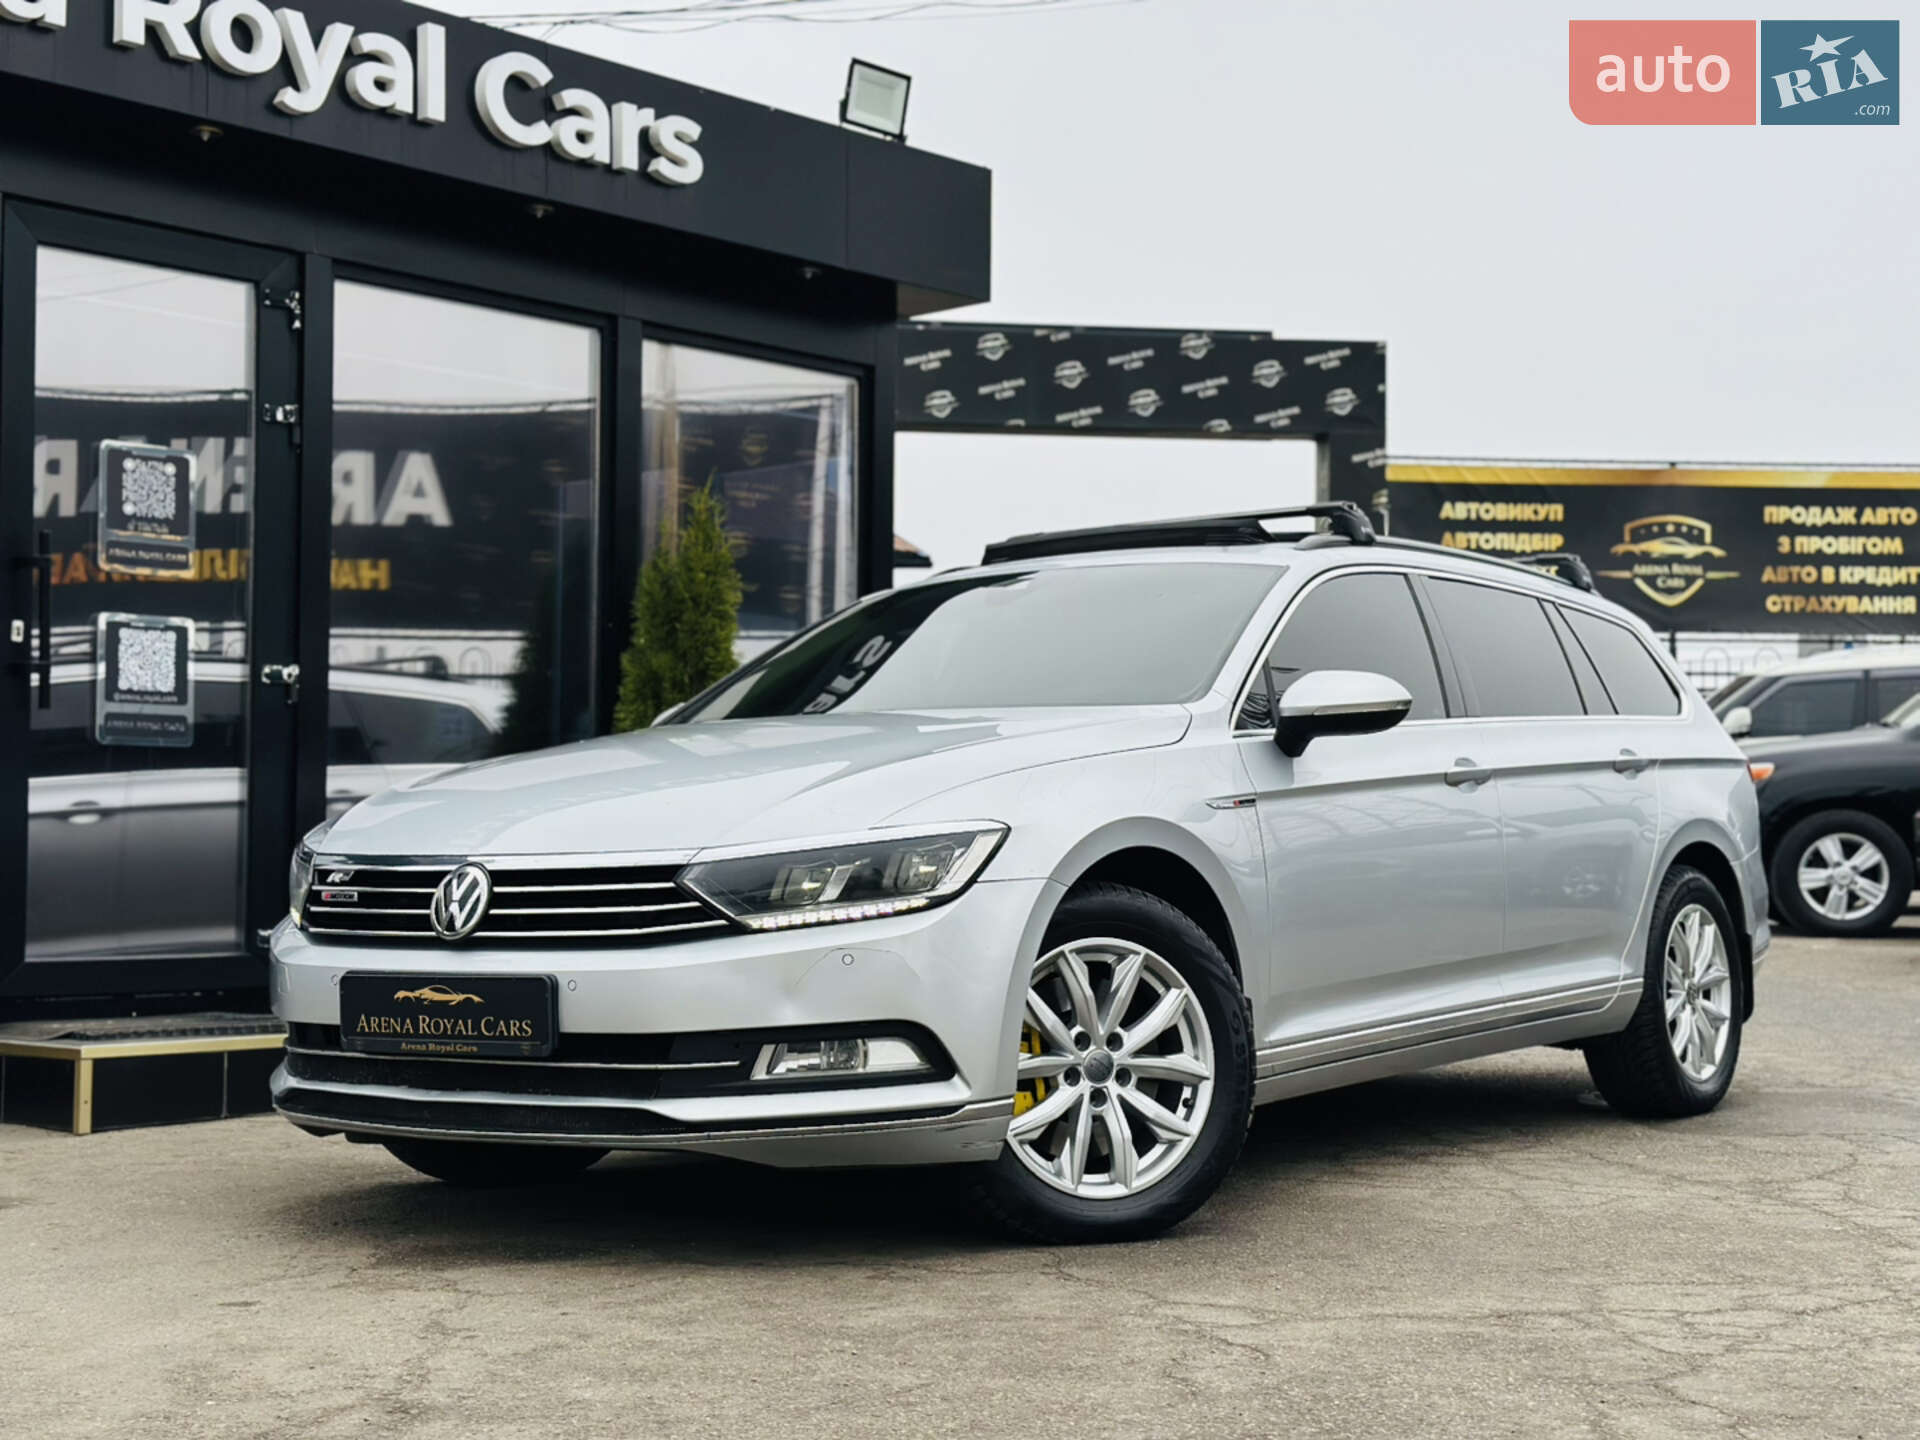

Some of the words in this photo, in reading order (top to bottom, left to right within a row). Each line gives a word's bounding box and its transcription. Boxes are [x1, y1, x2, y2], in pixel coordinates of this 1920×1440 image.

[113, 0, 446, 125] Royal
[475, 51, 704, 185] Cars
[1439, 502, 1565, 522] АВТОВИКУП
[1763, 505, 1857, 527] ПРОДАЖ
[1860, 506, 1918, 526] АВТО
[1441, 531, 1565, 553] АВТОПІДБІР
[1794, 535, 1904, 555] ПРОБІГОМ
[1761, 565, 1818, 583] АВТО
[1821, 565, 1836, 584] В
[1839, 565, 1920, 587] КРЕДИТ
[1764, 594, 1917, 614] СТРАХУВАННЯ
[356, 1013, 414, 1034] ARENA
[418, 1015, 478, 1036] ROYAL
[480, 1016, 533, 1037] CARS
